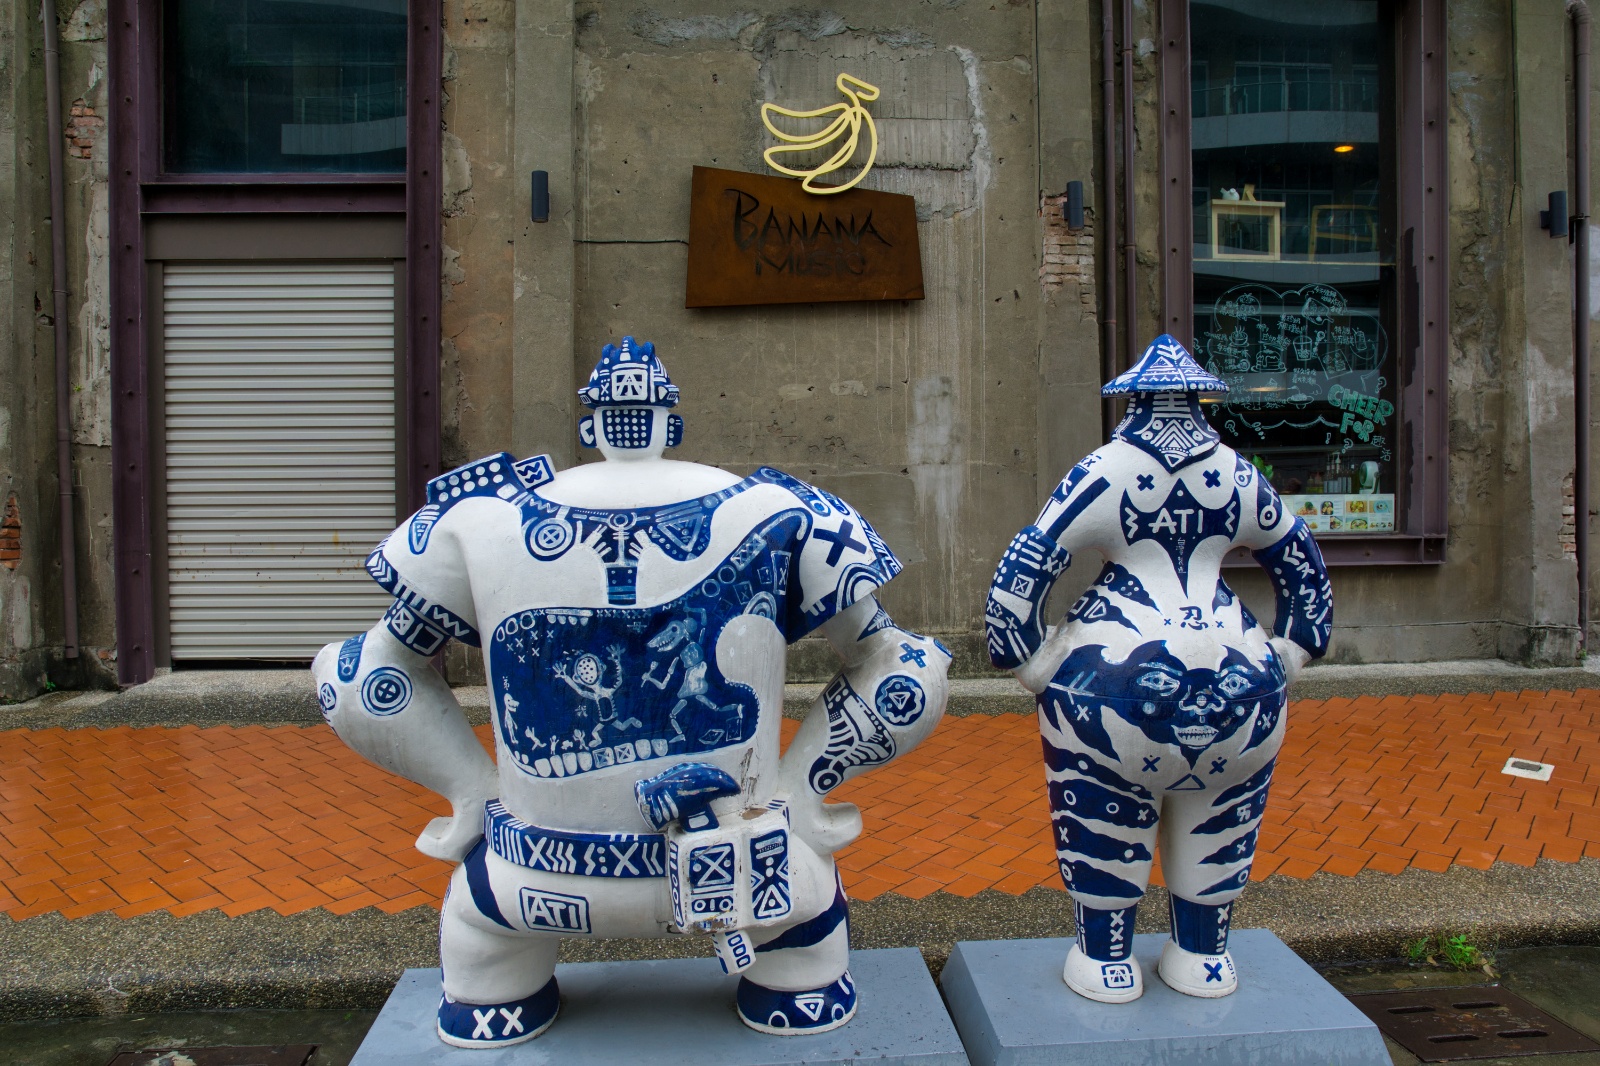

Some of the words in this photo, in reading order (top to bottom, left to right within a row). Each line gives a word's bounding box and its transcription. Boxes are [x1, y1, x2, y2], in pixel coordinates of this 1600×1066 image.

[1328, 384, 1394, 425] CHEER
[1148, 508, 1204, 534] ATI
[528, 896, 578, 928] ATI
